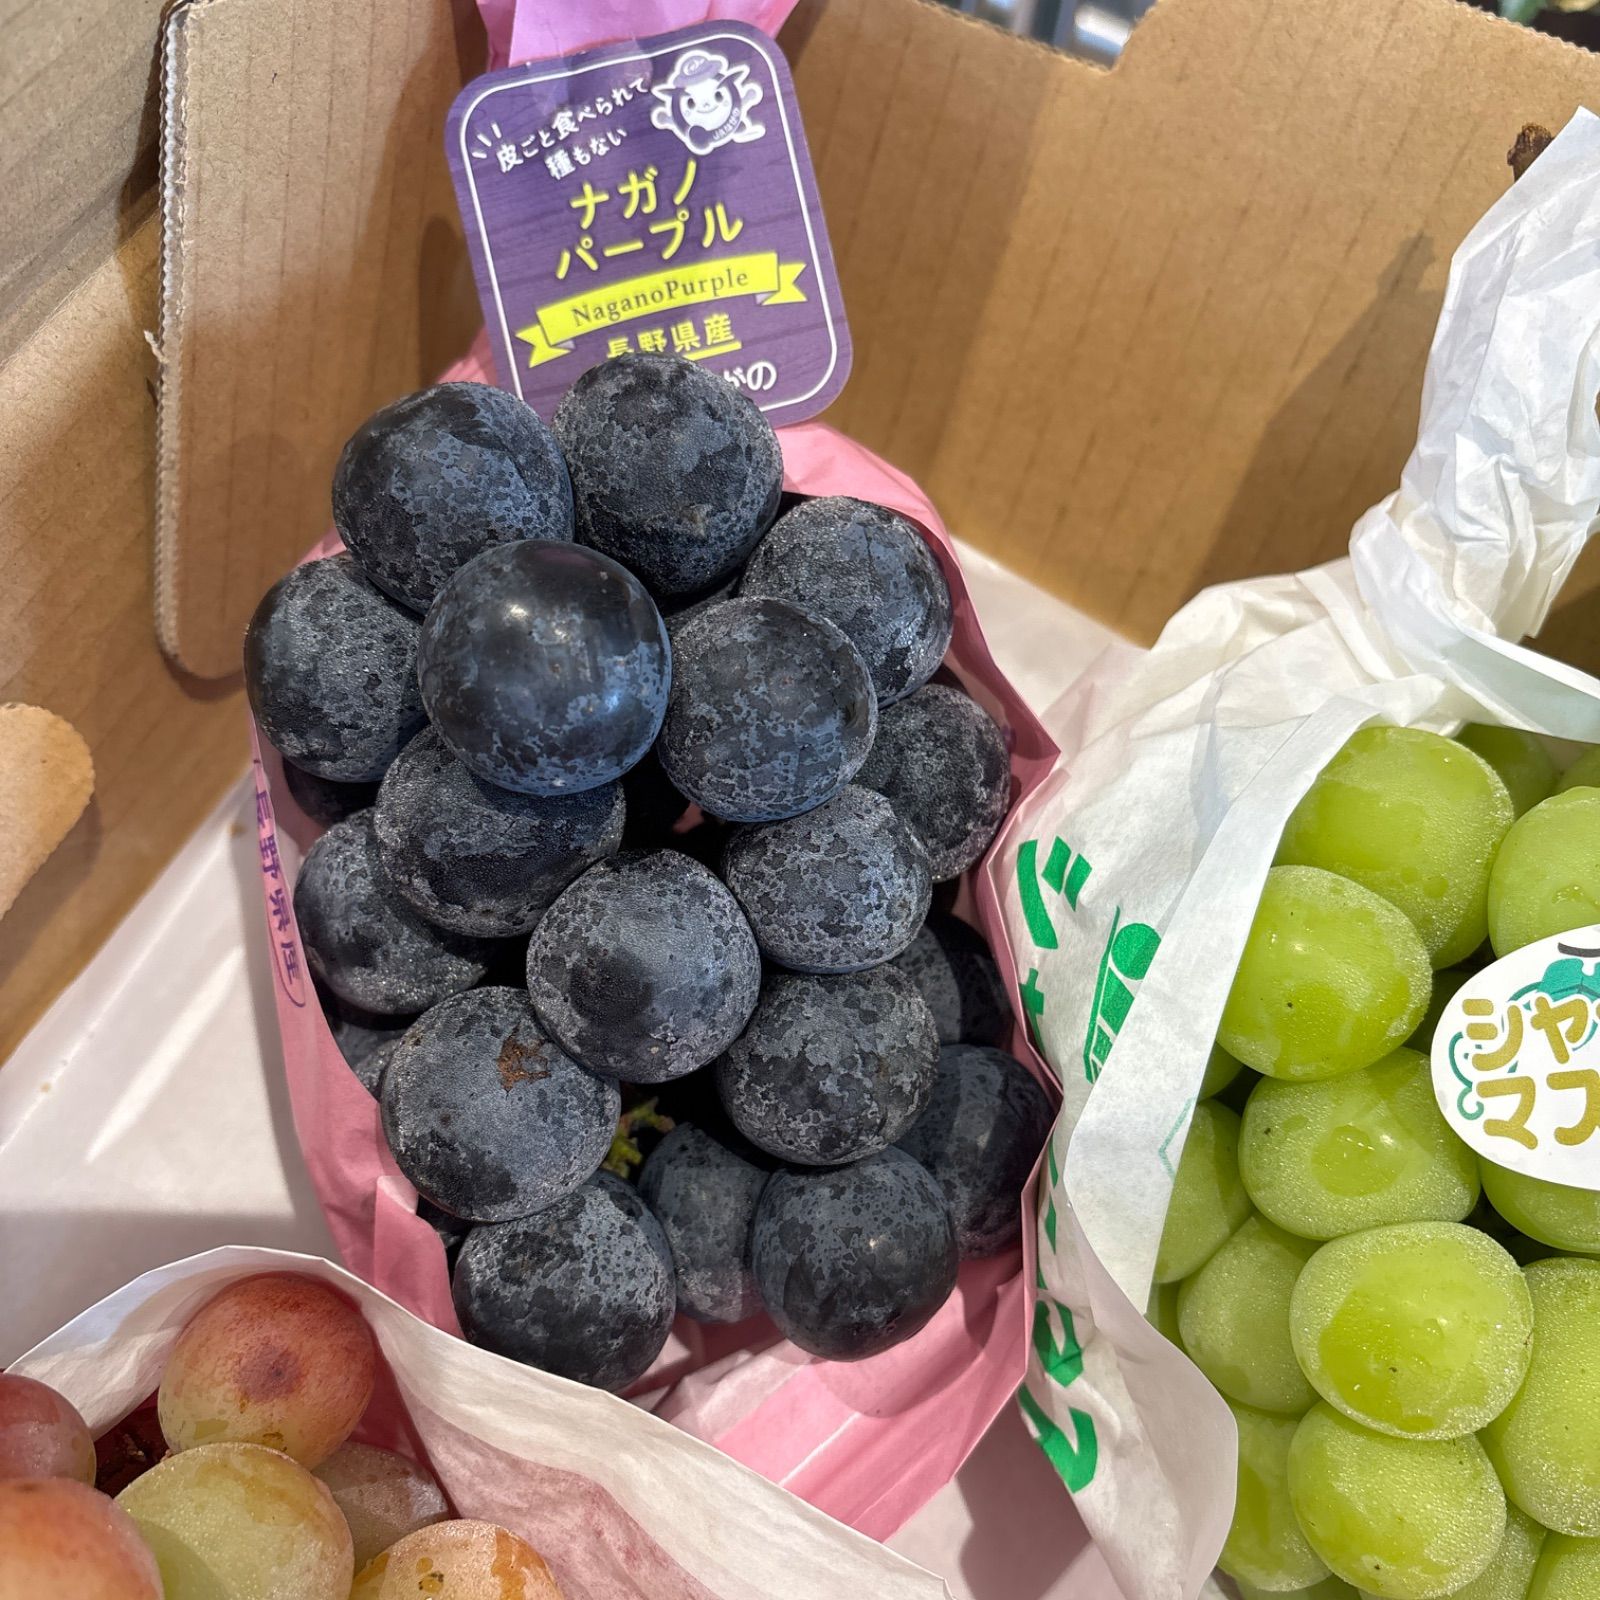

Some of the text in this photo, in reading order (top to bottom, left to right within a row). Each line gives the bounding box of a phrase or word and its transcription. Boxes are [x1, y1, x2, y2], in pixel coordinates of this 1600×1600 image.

[496, 78, 649, 173] 皮ごと食べられて
[545, 128, 628, 180] 種もない
[570, 160, 697, 230] ナガノ
[556, 202, 744, 280] パープル
[571, 268, 750, 328] NaganoPurple
[606, 312, 736, 358] 長野県産
[1462, 996, 1600, 1072] シャ
